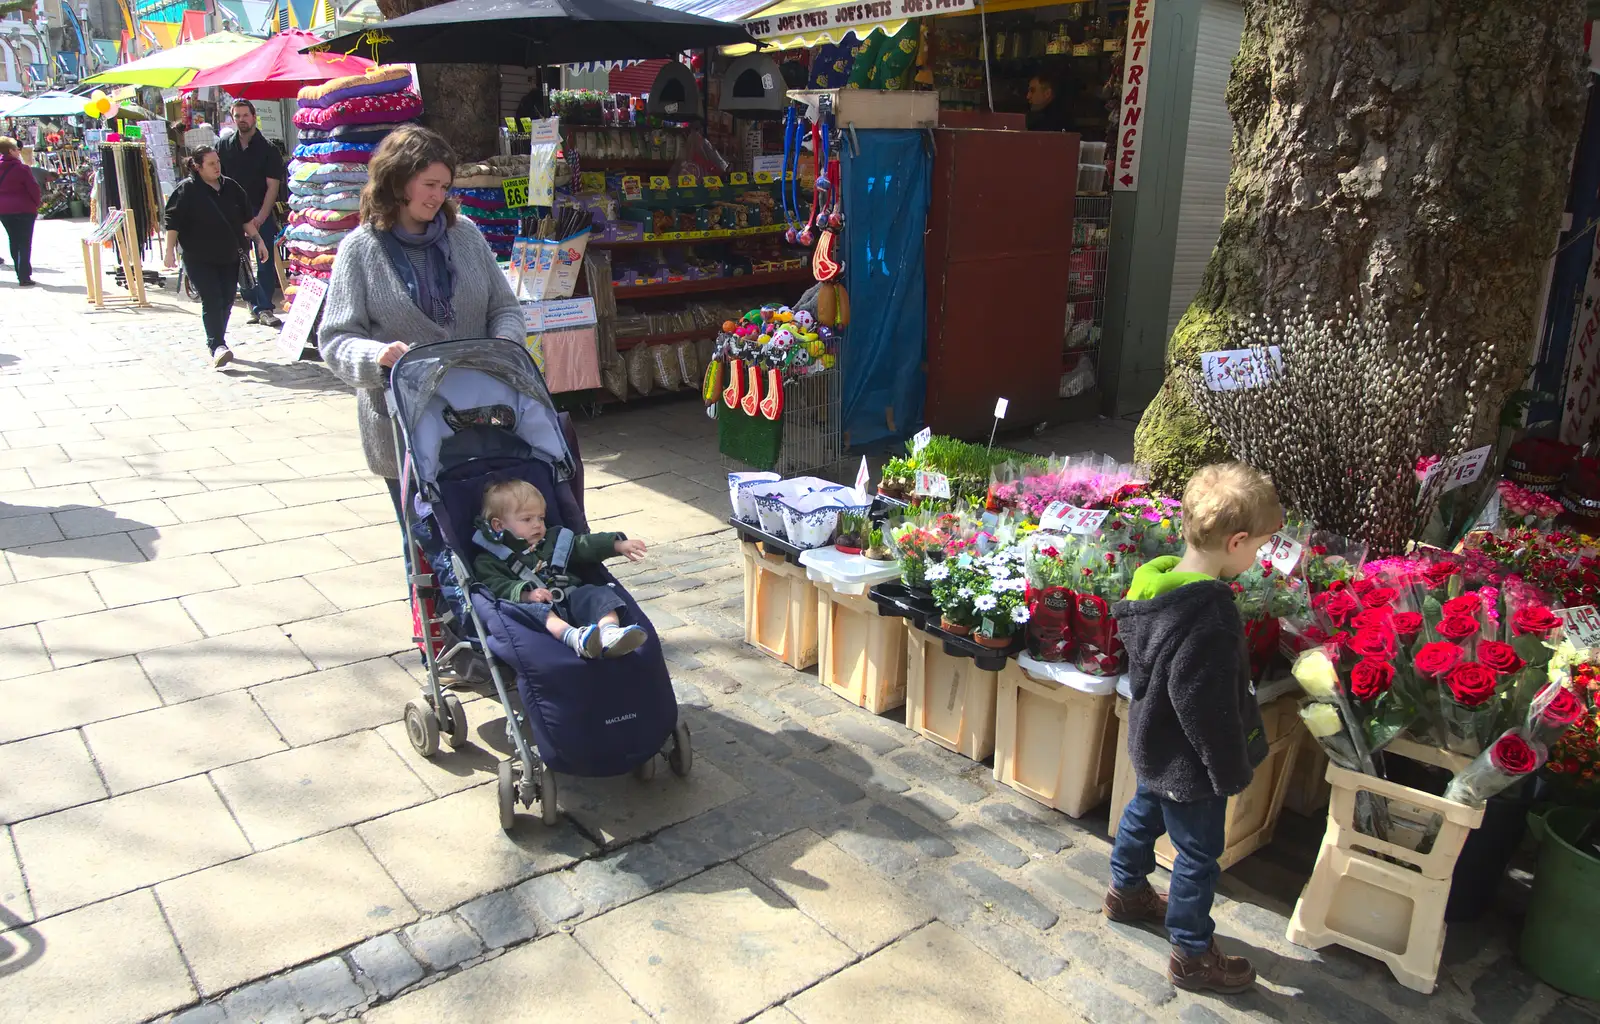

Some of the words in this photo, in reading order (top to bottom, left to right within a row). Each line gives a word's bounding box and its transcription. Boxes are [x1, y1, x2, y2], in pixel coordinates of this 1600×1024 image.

[748, 19, 770, 35] PETS
[777, 14, 803, 31] JOE'S
[803, 10, 828, 28] PETS
[835, 5, 863, 23] JOE'S
[864, 0, 892, 19] PETS
[1120, 0, 1150, 169] ENTRANCE
[504, 180, 519, 188] LARGE
[1044, 596, 1068, 608] Roses
[1078, 603, 1102, 617] Roses
[605, 712, 637, 725] MACLAREN
